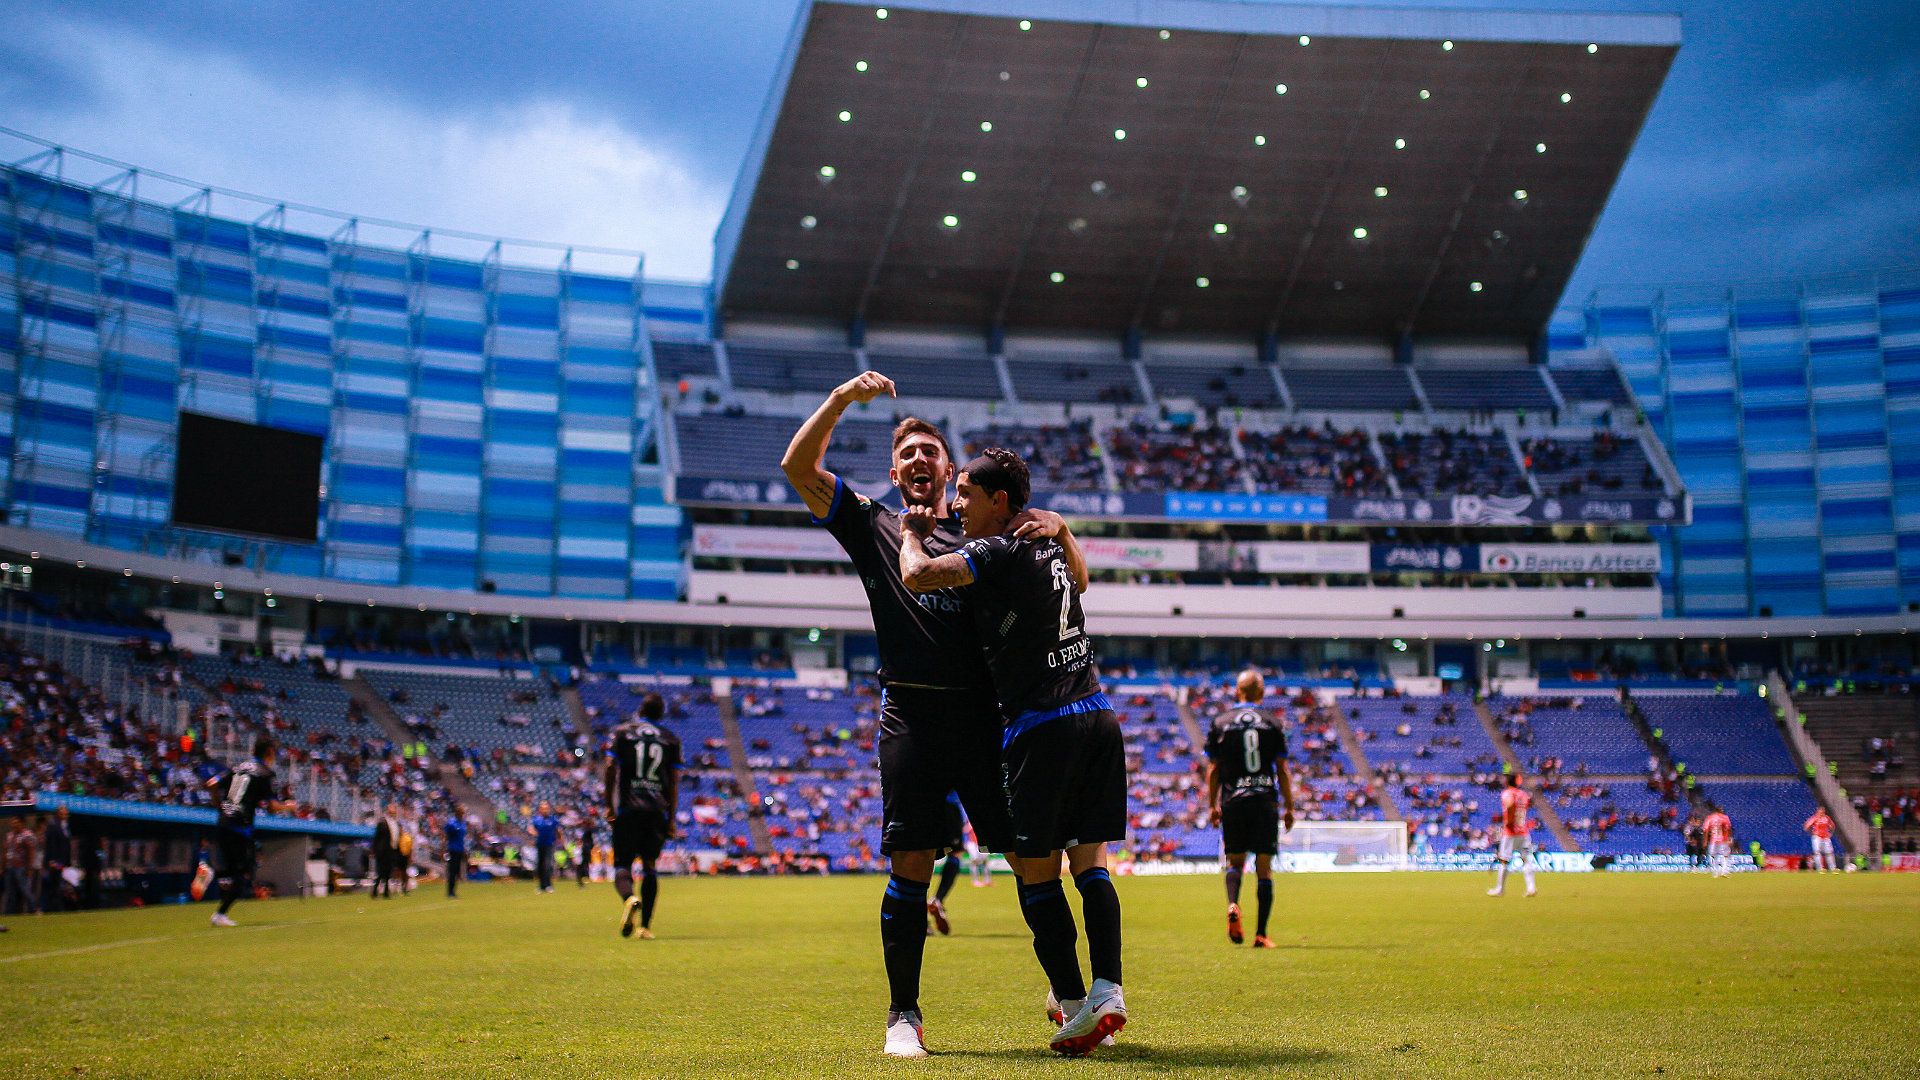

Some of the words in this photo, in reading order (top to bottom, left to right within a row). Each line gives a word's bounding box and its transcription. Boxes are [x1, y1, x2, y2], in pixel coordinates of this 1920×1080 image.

[1525, 555, 1584, 571] Banco
[1590, 554, 1656, 571] Azteca
[1049, 558, 1081, 641] 2
[634, 740, 664, 781] 12
[1243, 728, 1261, 774] 8
